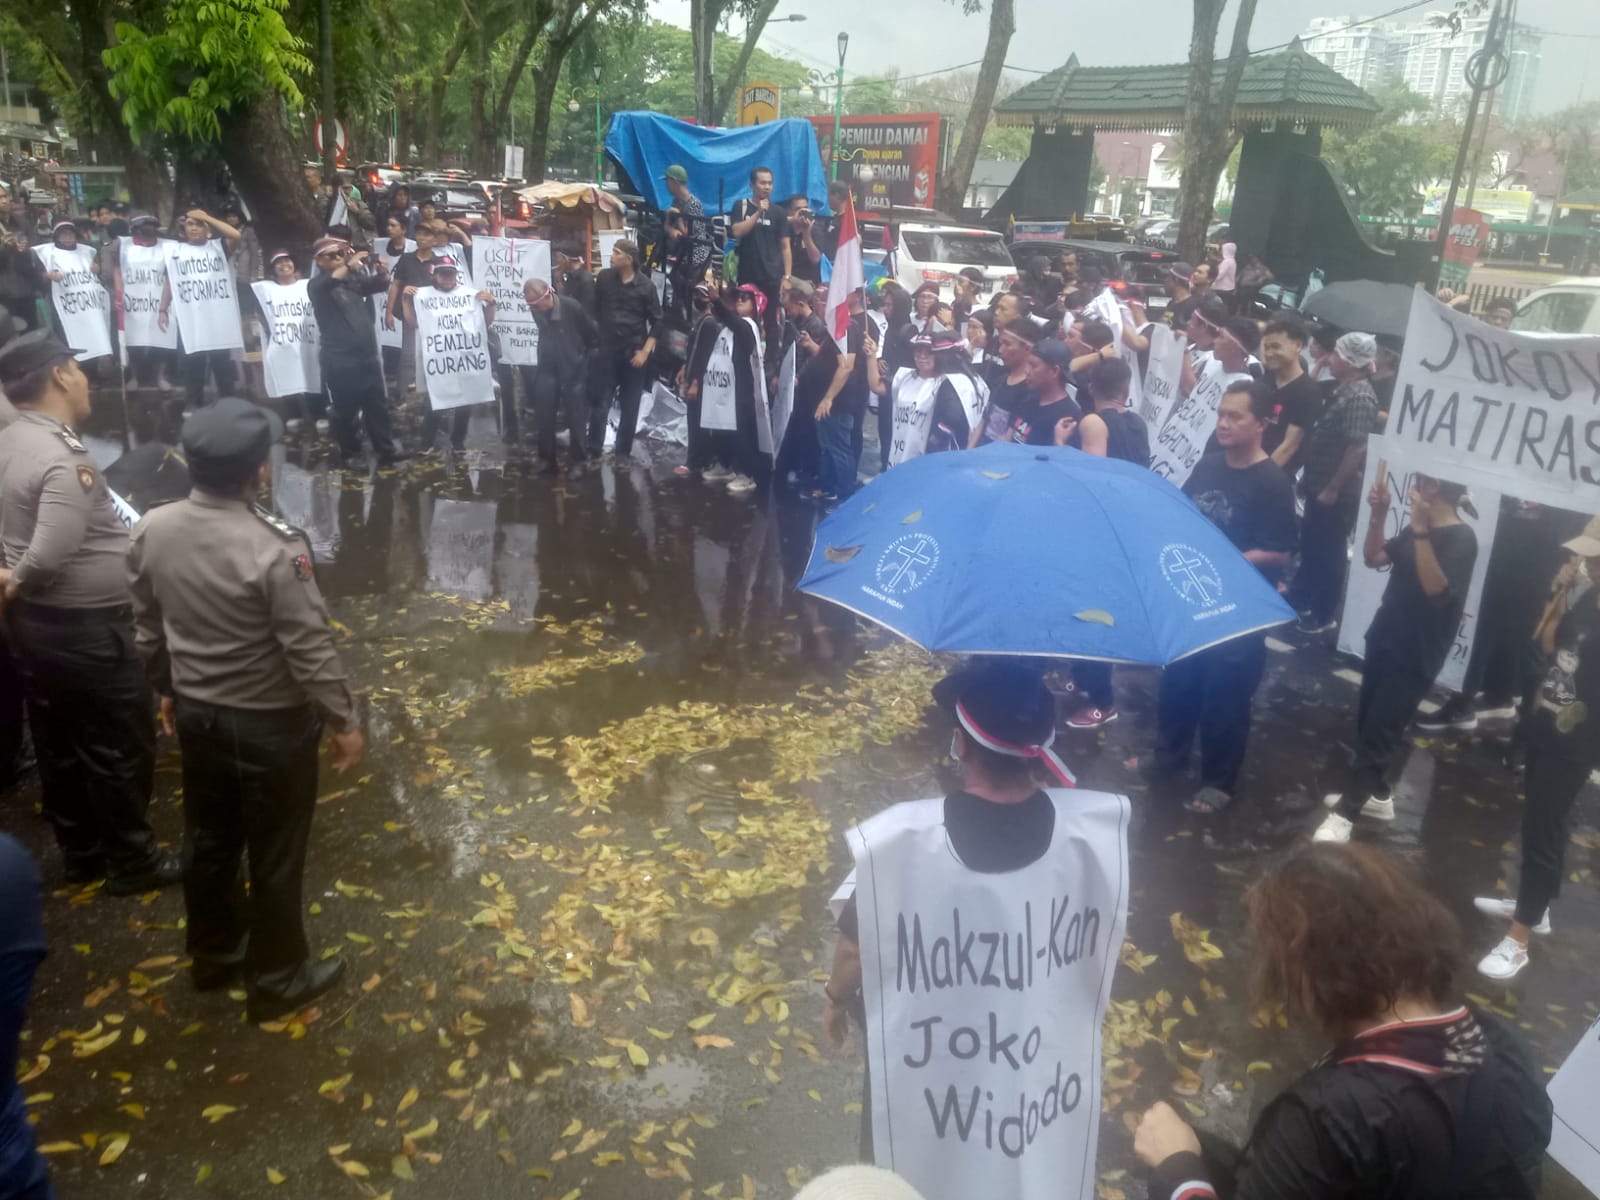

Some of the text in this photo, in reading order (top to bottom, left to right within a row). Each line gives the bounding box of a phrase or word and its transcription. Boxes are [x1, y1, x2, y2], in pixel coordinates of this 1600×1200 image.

[840, 127, 929, 145] PEMILU DAMAI
[172, 252, 225, 276] Tuntaskan
[484, 264, 524, 281] APBN
[177, 278, 230, 303] REFORMASI
[426, 332, 482, 353] PEMILU
[426, 352, 487, 376] CURANG
[896, 894, 1101, 994] Makzul-Kan
[902, 1011, 1042, 1071] Joko
[923, 1061, 1083, 1159] Widodo
